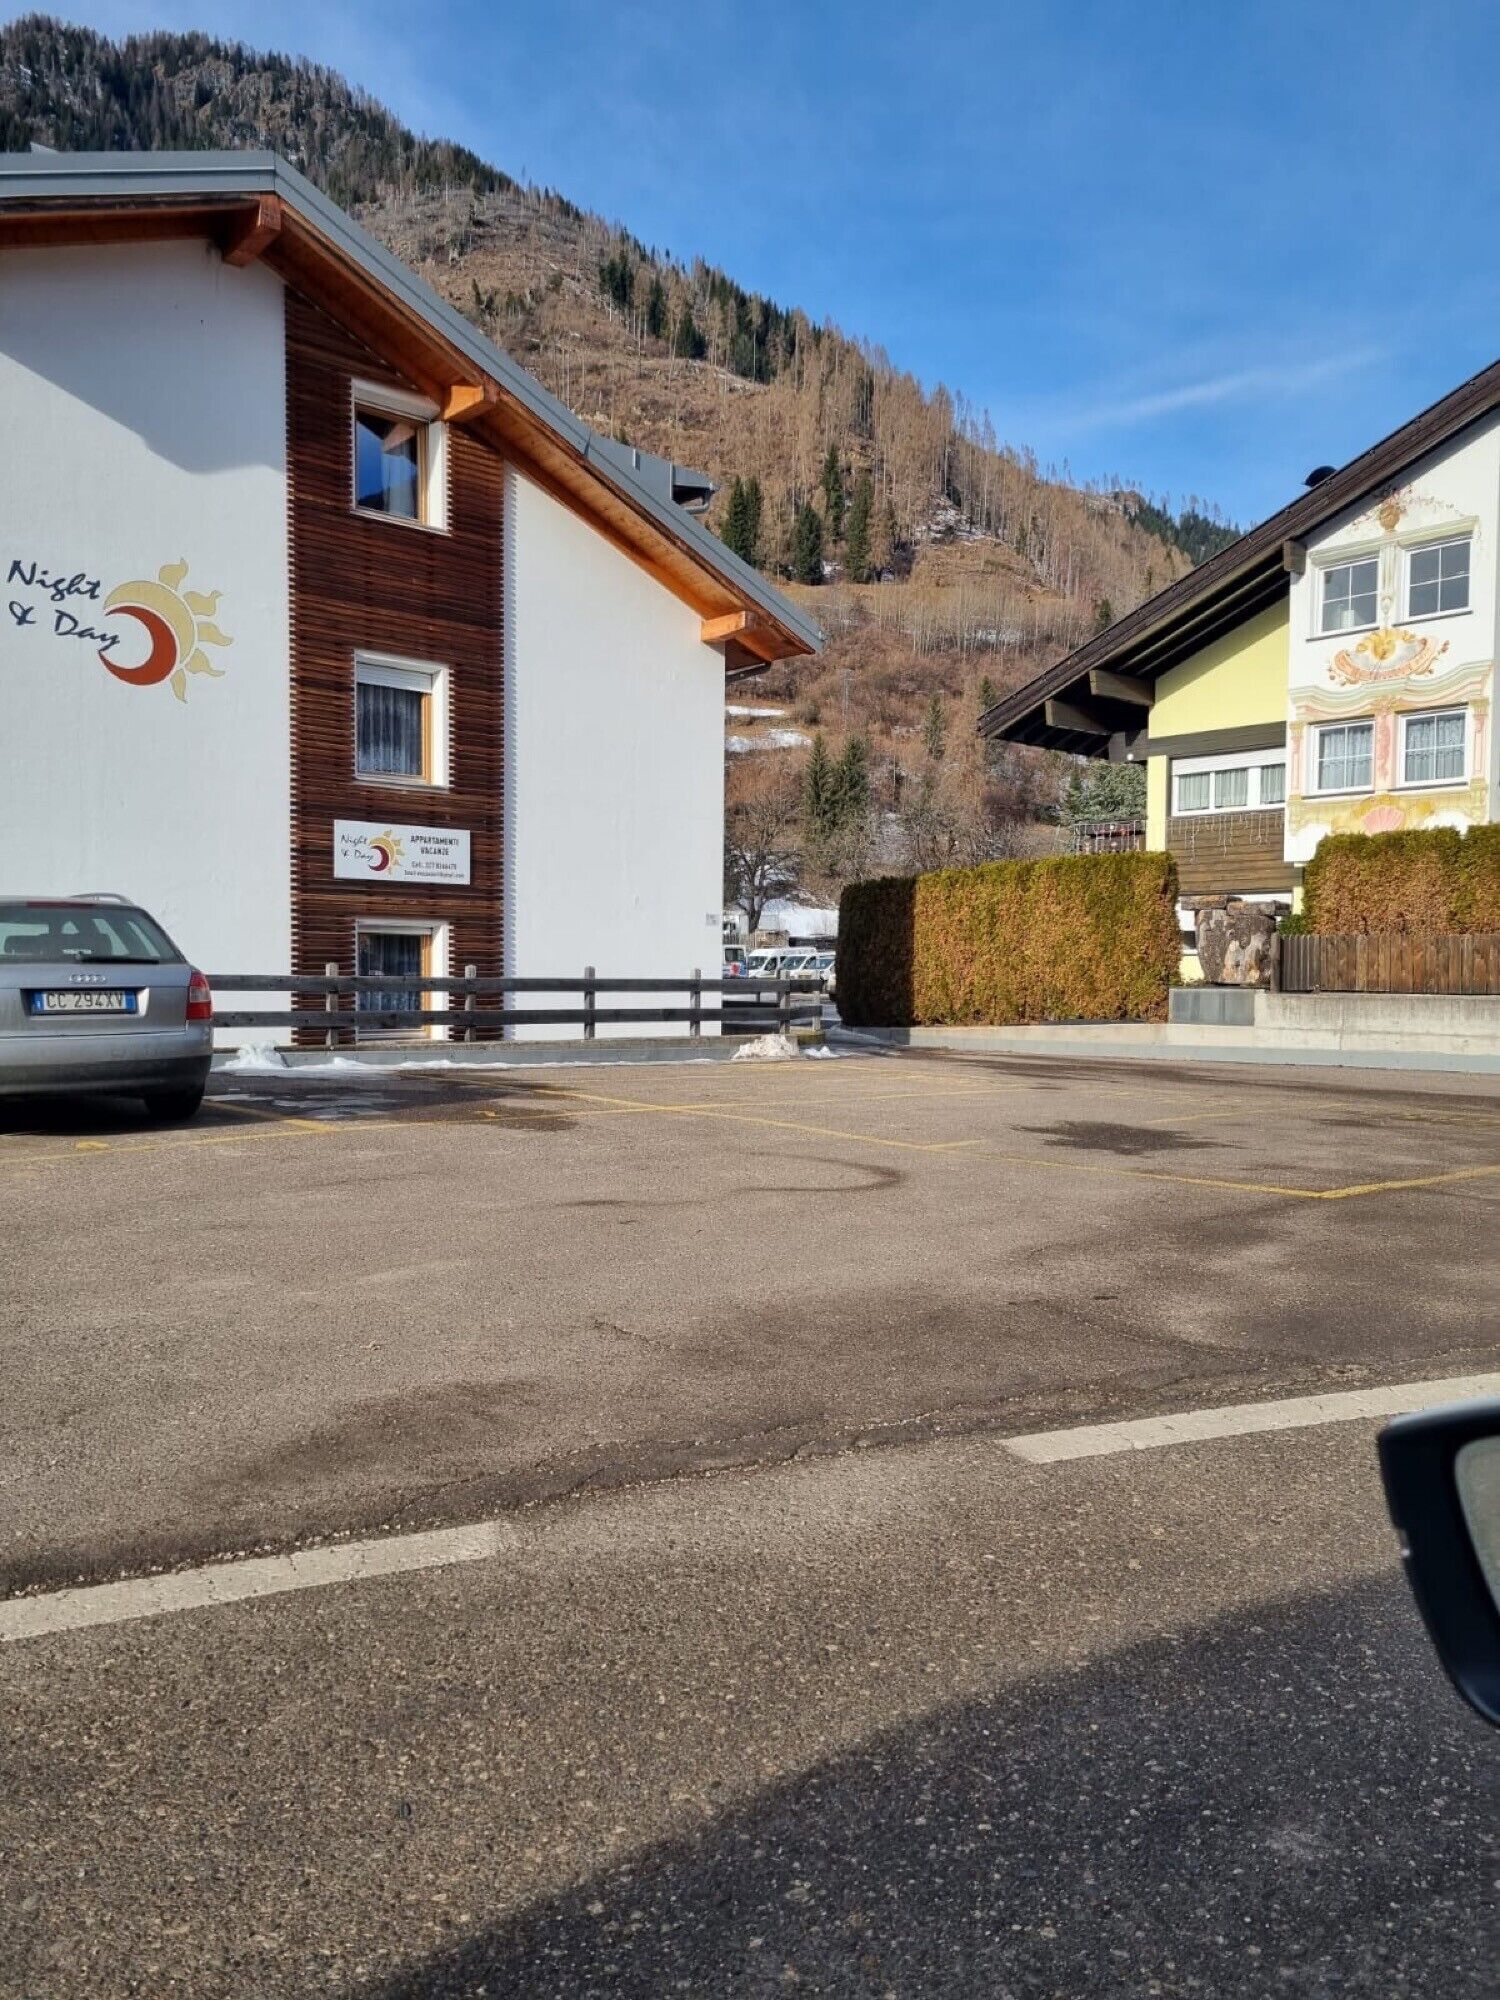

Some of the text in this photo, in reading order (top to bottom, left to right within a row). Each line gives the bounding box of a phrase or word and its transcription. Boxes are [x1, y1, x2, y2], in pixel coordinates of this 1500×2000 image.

[7, 560, 101, 602] Night
[8, 600, 120, 654] & Day
[340, 833, 368, 846] Night
[410, 835, 460, 846] APPARTAMENTI
[354, 849, 374, 862] Day
[420, 847, 450, 856] VACANZE
[46, 992, 124, 1008] CC 294XV
